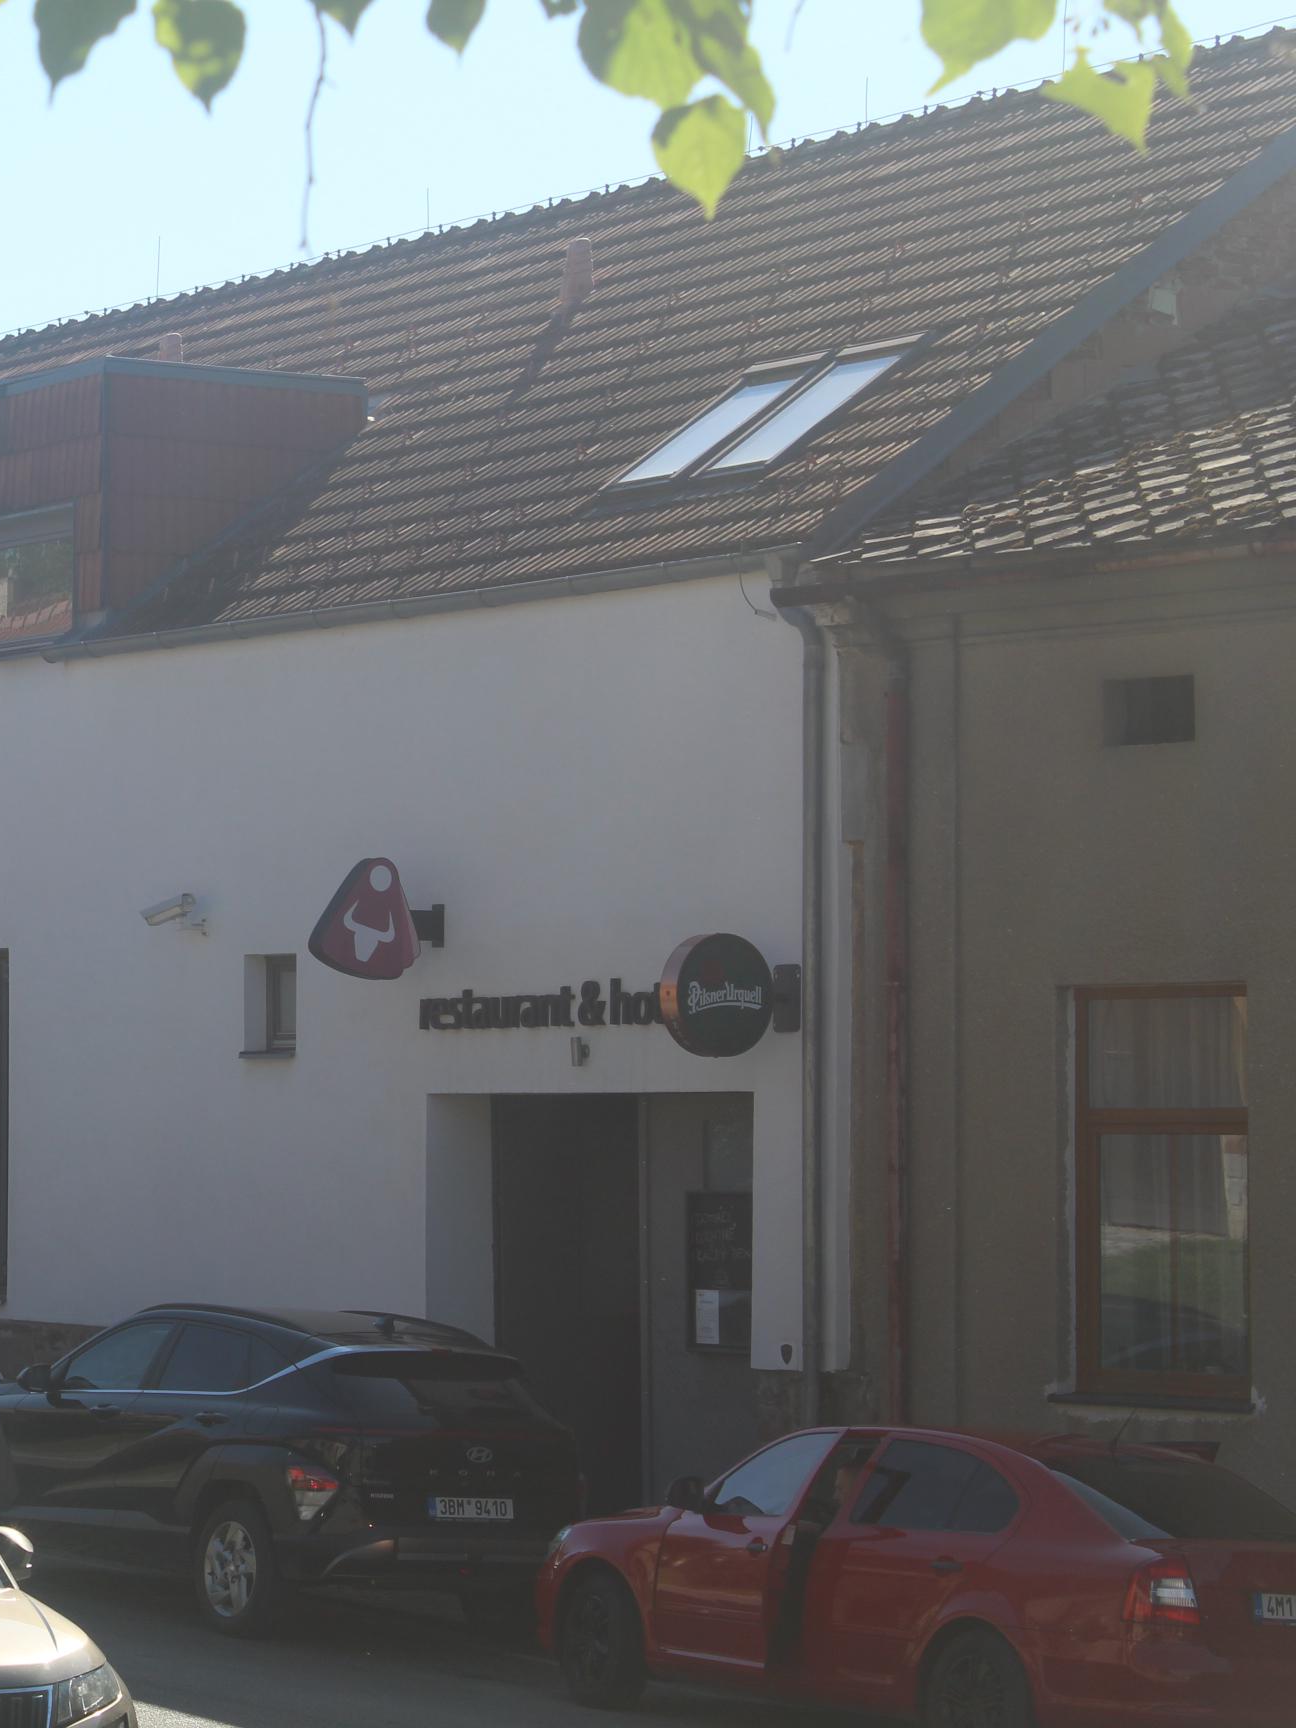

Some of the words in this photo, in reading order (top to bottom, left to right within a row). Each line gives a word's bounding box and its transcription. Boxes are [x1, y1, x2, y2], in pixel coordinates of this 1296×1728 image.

[419, 985, 576, 1030] restaurant
[578, 980, 606, 1026] &
[687, 980, 727, 1014] Pilsner
[724, 980, 763, 1010] Urquell
[439, 1498, 465, 1516] 3BM
[474, 1500, 508, 1517] 9410
